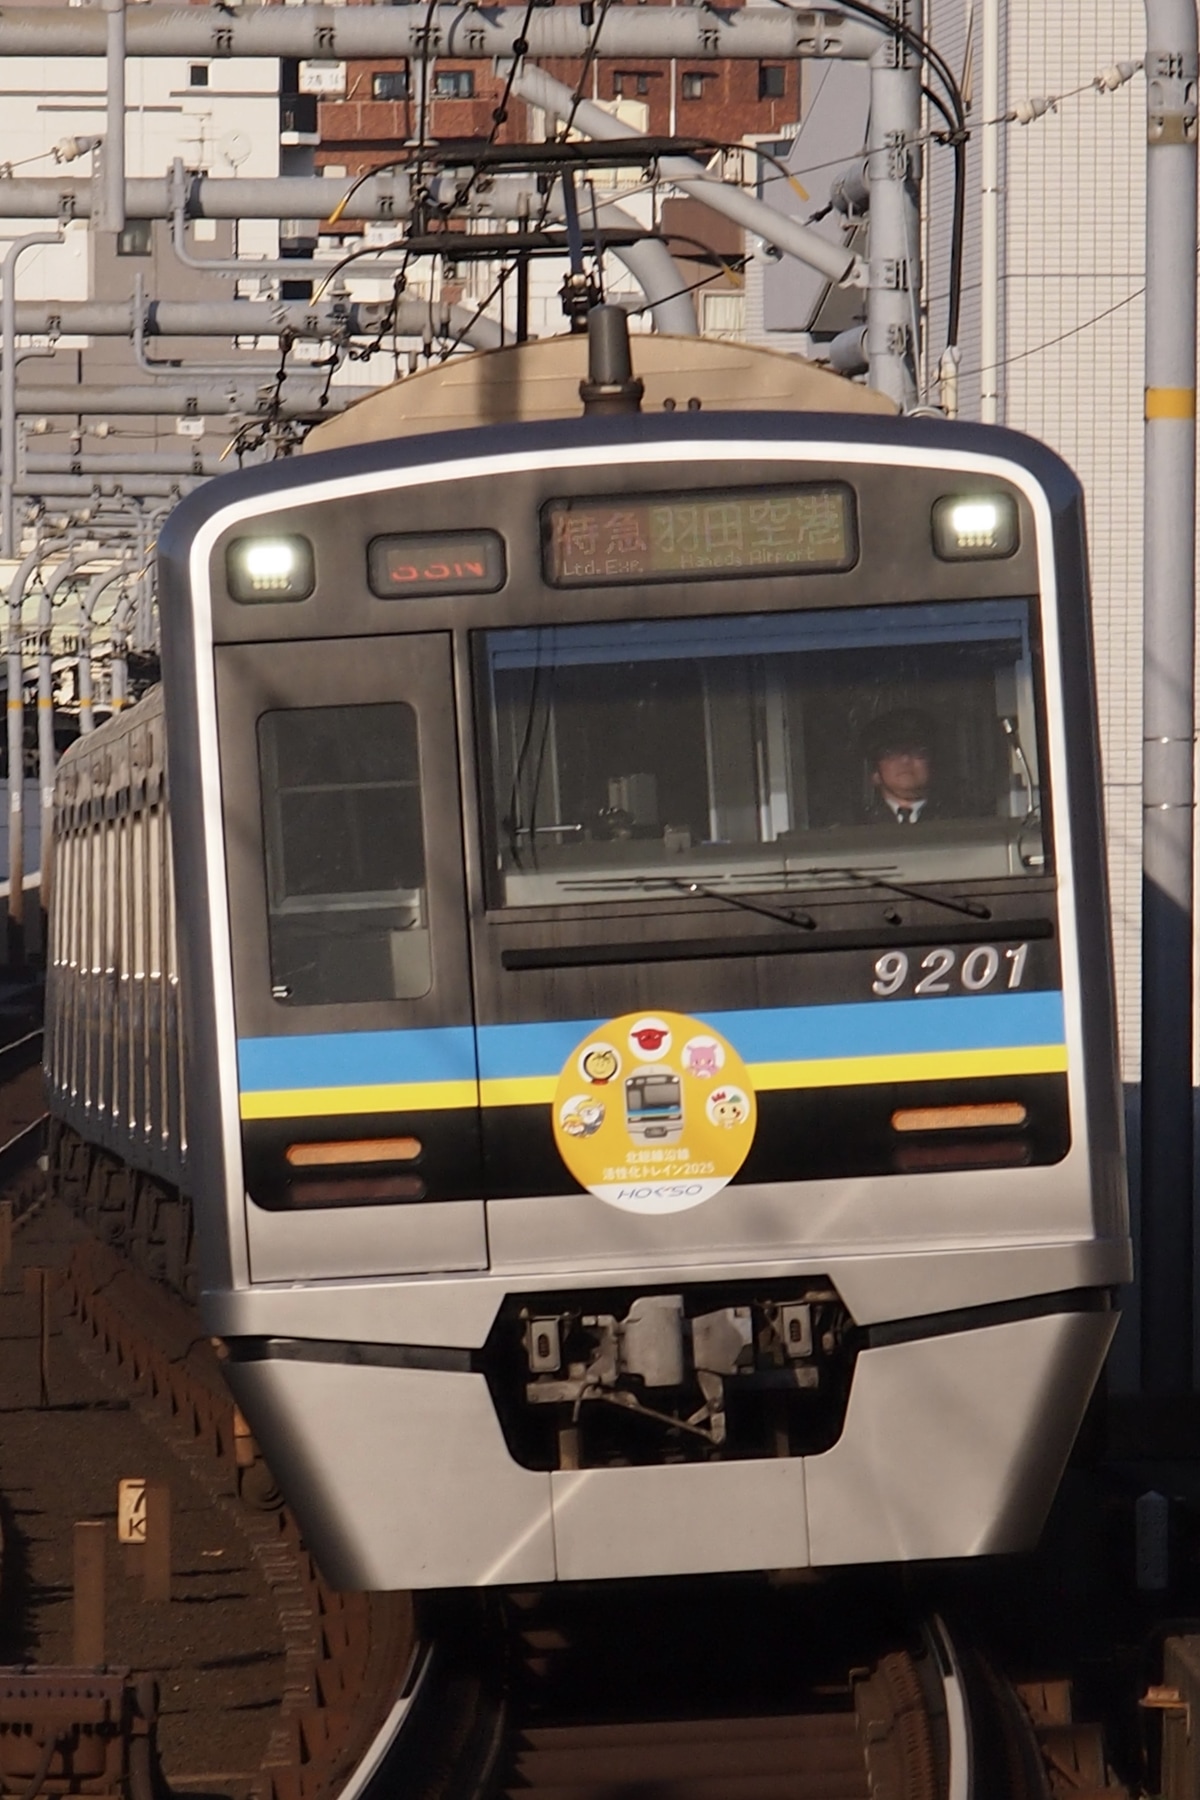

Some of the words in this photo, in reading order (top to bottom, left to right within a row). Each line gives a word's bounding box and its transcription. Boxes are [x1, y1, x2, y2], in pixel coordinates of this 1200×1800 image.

[556, 512, 647, 555] 特急
[652, 492, 841, 552] 羽田空港
[872, 943, 1028, 996] 9201
[125, 1484, 147, 1514] 7
[128, 1517, 147, 1538] K
